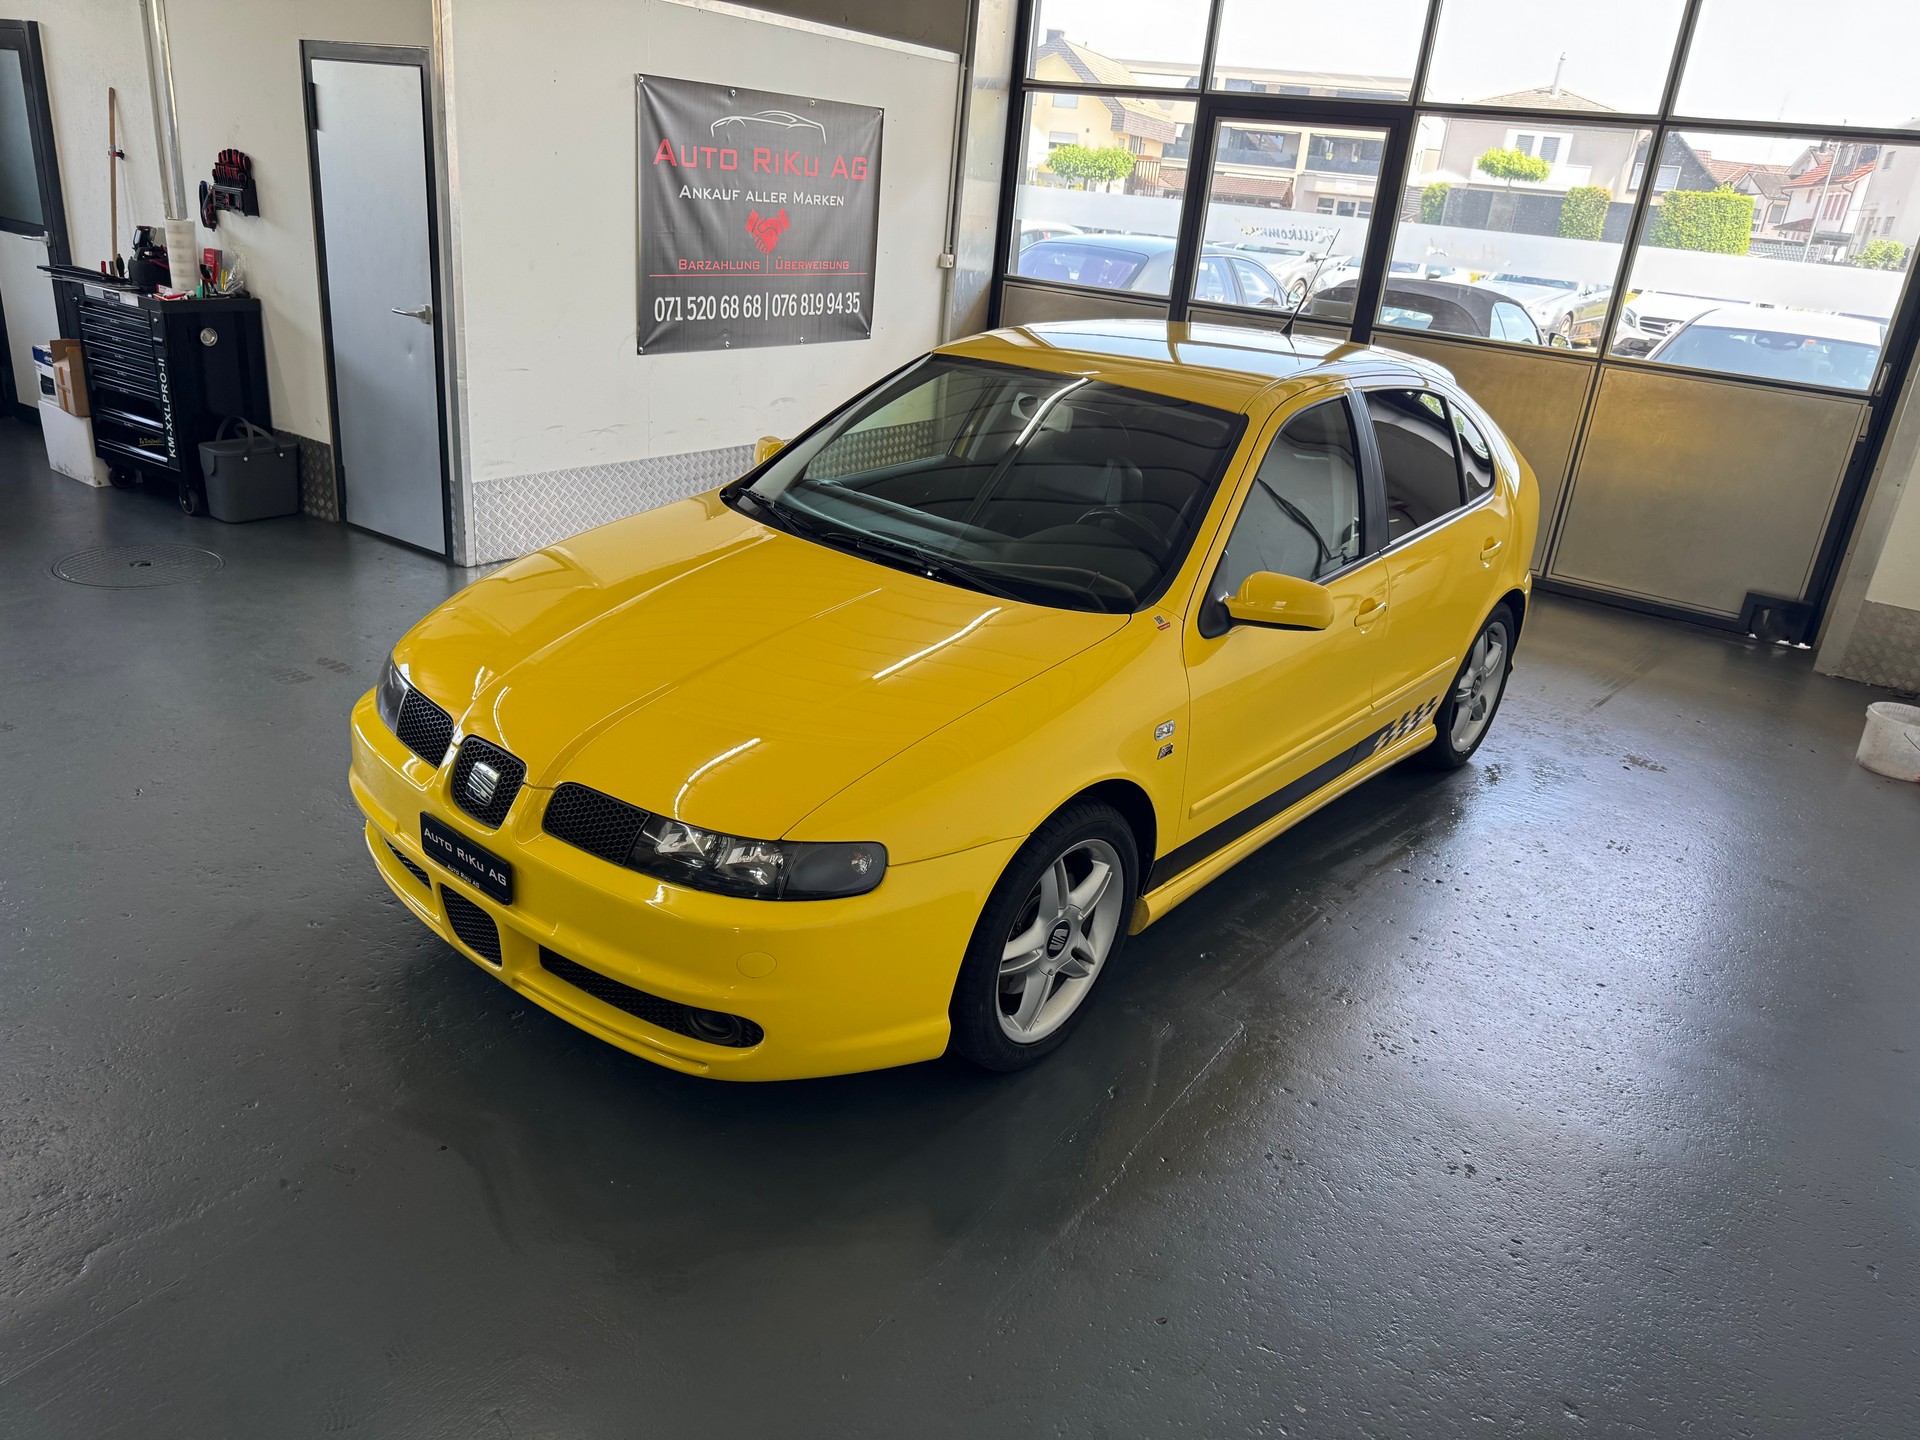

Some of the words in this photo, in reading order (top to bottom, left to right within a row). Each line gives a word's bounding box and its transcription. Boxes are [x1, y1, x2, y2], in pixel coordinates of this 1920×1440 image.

[831, 155, 869, 181] AG
[679, 184, 740, 201] ANKAUF
[745, 190, 787, 204] ALLER
[793, 191, 845, 207] MARKEN
[678, 259, 760, 271] BARZAHLUNG
[654, 296, 684, 322] 071
[687, 295, 717, 321] 520
[720, 294, 740, 319] 68
[743, 294, 762, 318] 68
[771, 293, 797, 317] 076
[800, 292, 824, 316] 819
[826, 292, 843, 315] 94
[845, 291, 861, 314] 35
[158, 358, 177, 458] KM-XXLPRO-II
[488, 868, 507, 887] AG
